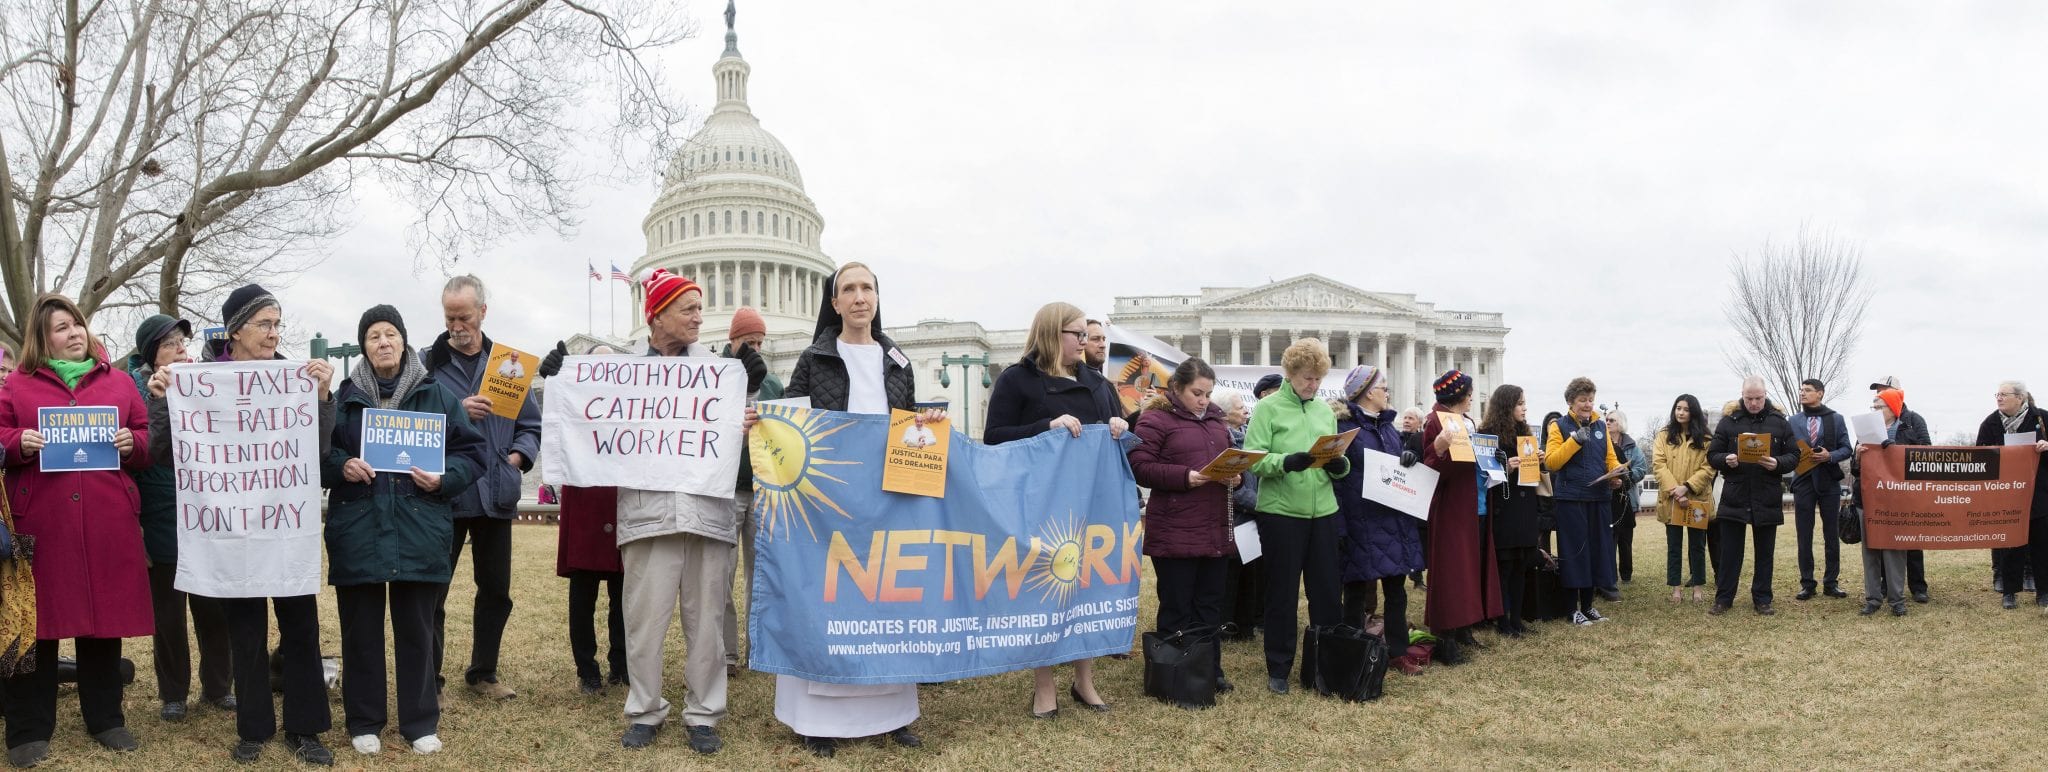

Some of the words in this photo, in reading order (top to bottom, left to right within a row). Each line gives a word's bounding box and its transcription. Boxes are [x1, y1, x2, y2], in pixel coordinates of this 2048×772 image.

[212, 332, 229, 340] STA
[175, 371, 218, 397] U.S.
[234, 364, 314, 395] TAXES
[488, 376, 513, 389] JUSTICE
[513, 384, 525, 393] FOR
[488, 385, 520, 400] DREAMERS
[584, 396, 723, 423] CATHOLIC
[42, 414, 46, 427] I
[49, 413, 85, 427] STAND
[88, 413, 115, 426] WITH
[178, 410, 221, 433] ICE
[237, 402, 313, 432] RAIDS
[367, 414, 372, 427] I
[375, 414, 411, 429] STAND
[414, 417, 442, 432] WITH
[42, 426, 116, 444] DREAMERS
[366, 427, 442, 448] DREAMERS
[592, 428, 720, 459] WORKER
[179, 438, 299, 465] DETENTION
[891, 448, 922, 459] JUSTICIA
[924, 454, 943, 462] PARA
[1909, 450, 1973, 463] FRANCISCAN
[889, 457, 903, 465] LOS
[904, 460, 943, 471] DREAMERS
[1909, 461, 1944, 473] ACTION
[1944, 462, 1987, 473] NETWORK
[178, 462, 309, 494] DEPORTATION
[1876, 480, 1884, 490] A
[1886, 480, 1923, 491] Unified
[1925, 482, 1982, 492] Franciscan
[1984, 481, 2011, 491] Voice
[2013, 480, 2026, 490] for
[1934, 495, 1971, 504] Justice
[183, 503, 254, 533] DON'T
[261, 500, 307, 530] PAY
[1875, 509, 1890, 517] Find
[1911, 511, 1945, 519] Facebook
[2001, 508, 2023, 516] Twitter
[1867, 517, 1952, 527] FranciscanActionNetwork
[1894, 531, 2006, 543] www.franciscanaction.org
[827, 619, 904, 635] ADVOCATES
[908, 619, 937, 635] FOR
[941, 616, 983, 633] JUSTICE,
[986, 613, 1048, 630] INSPIRED
[1051, 611, 1066, 626] BY
[1115, 595, 1139, 612] SISTE
[827, 640, 961, 657] www.networklobby.org
[975, 634, 1033, 649] NETWORK
